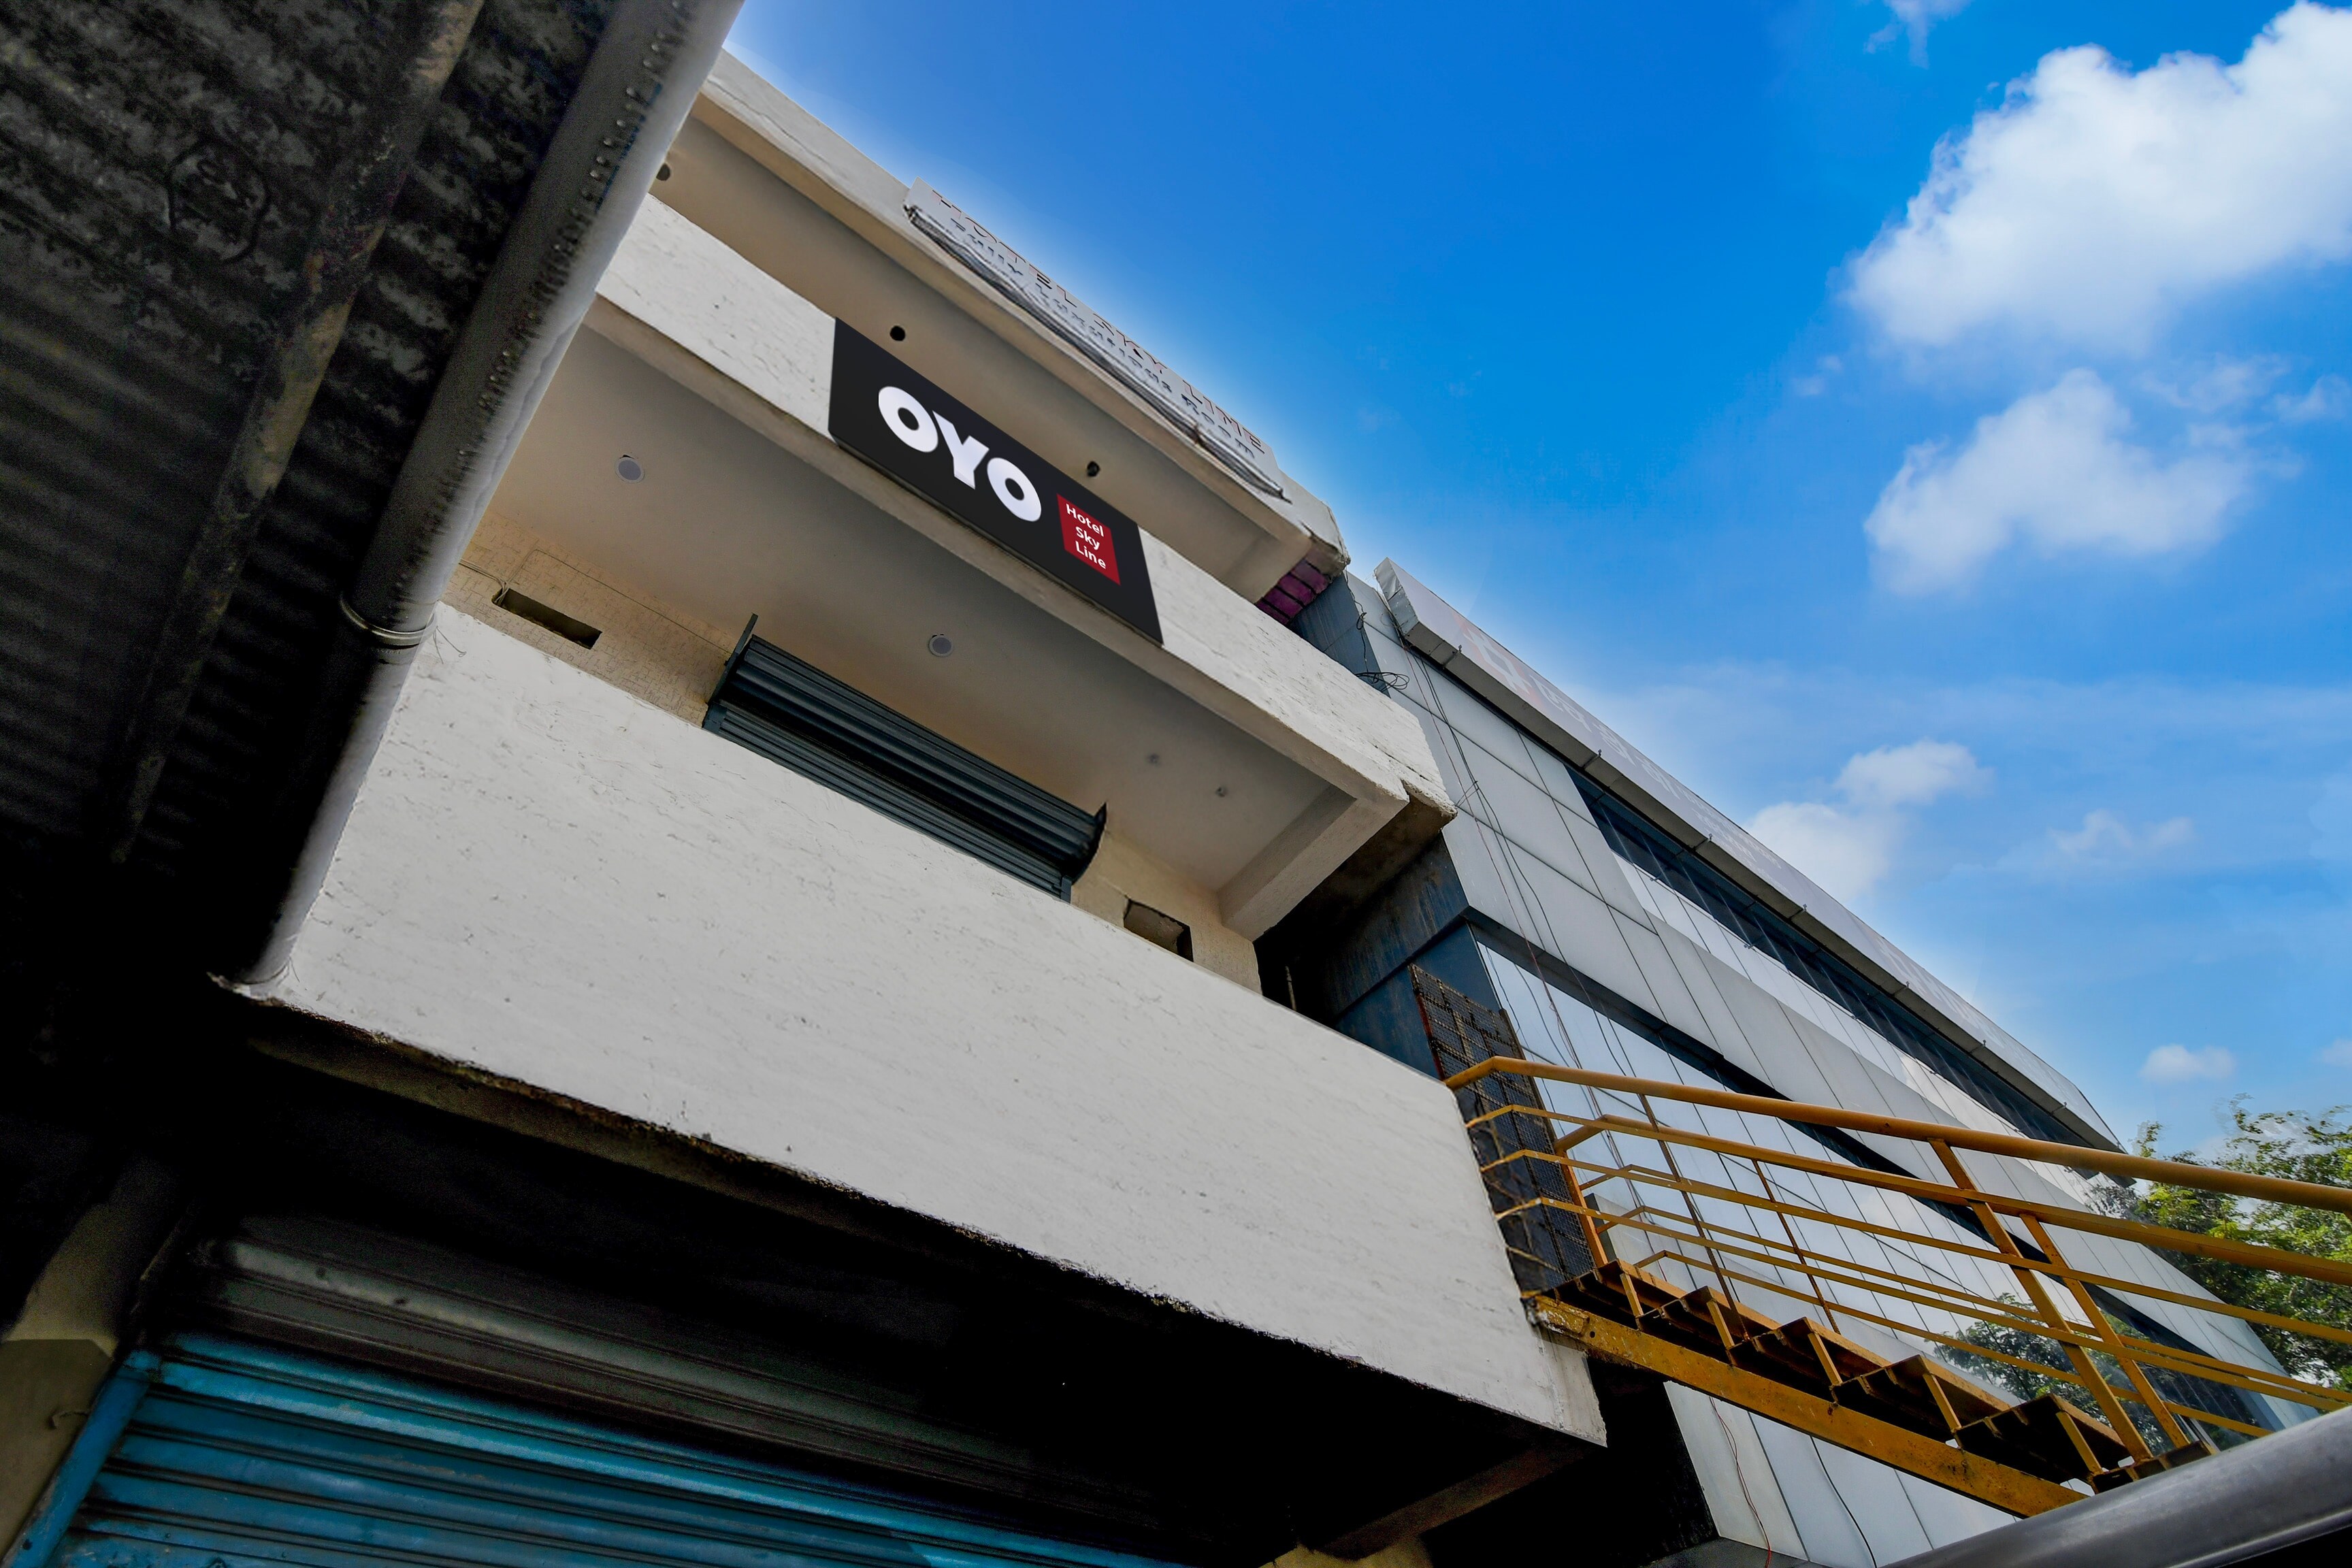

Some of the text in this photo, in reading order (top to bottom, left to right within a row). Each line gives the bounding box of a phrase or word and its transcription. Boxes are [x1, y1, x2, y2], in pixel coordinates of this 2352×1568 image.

[931, 189, 1265, 455] HOTEL SKY LINE
[878, 386, 1042, 522] OYO
[1066, 503, 1105, 537] Hotel
[1075, 526, 1100, 551] Sky
[1075, 540, 1107, 569] Line
